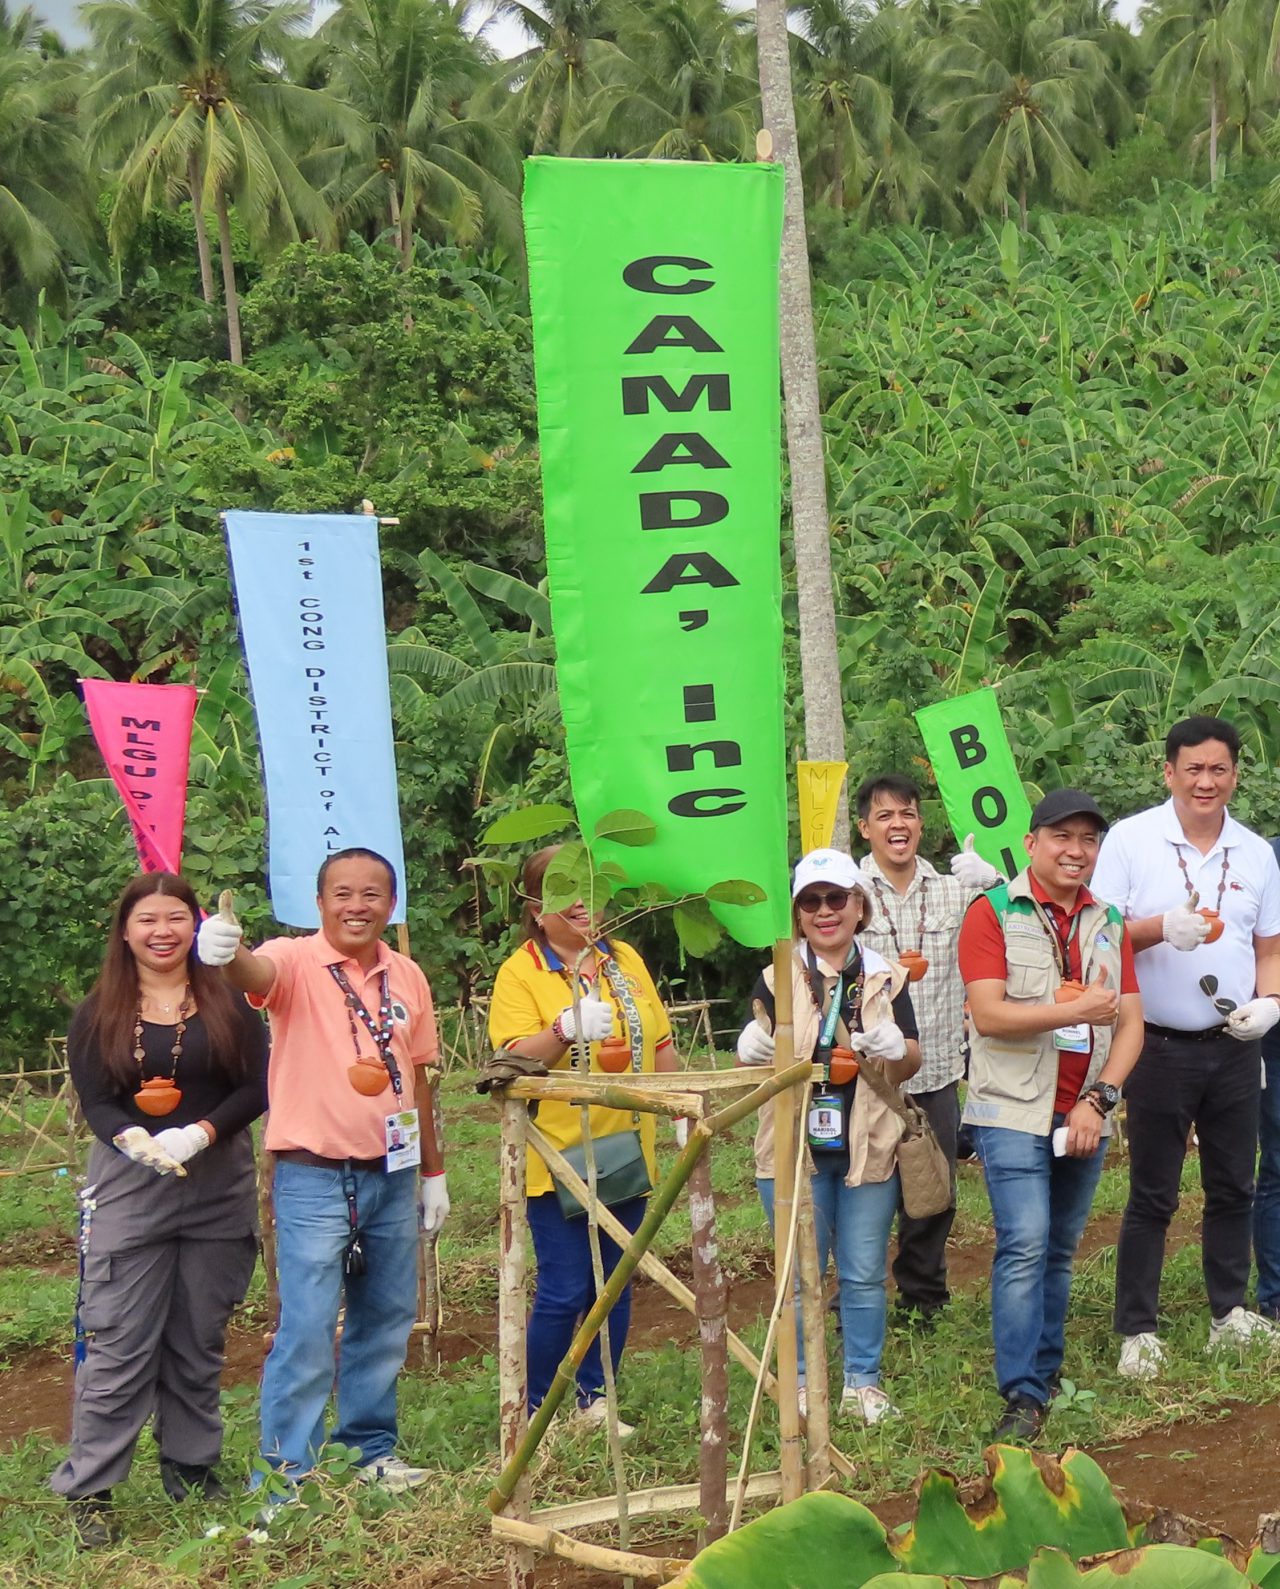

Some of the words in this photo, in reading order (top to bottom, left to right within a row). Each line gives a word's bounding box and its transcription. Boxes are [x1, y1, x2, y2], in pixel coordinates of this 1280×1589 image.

[297, 541, 315, 580] 1st
[299, 598, 326, 651] CONG
[121, 716, 161, 778] MLGU
[305, 667, 332, 777] DISTRICT
[320, 790, 336, 812] of
[809, 767, 828, 849] MLGU
